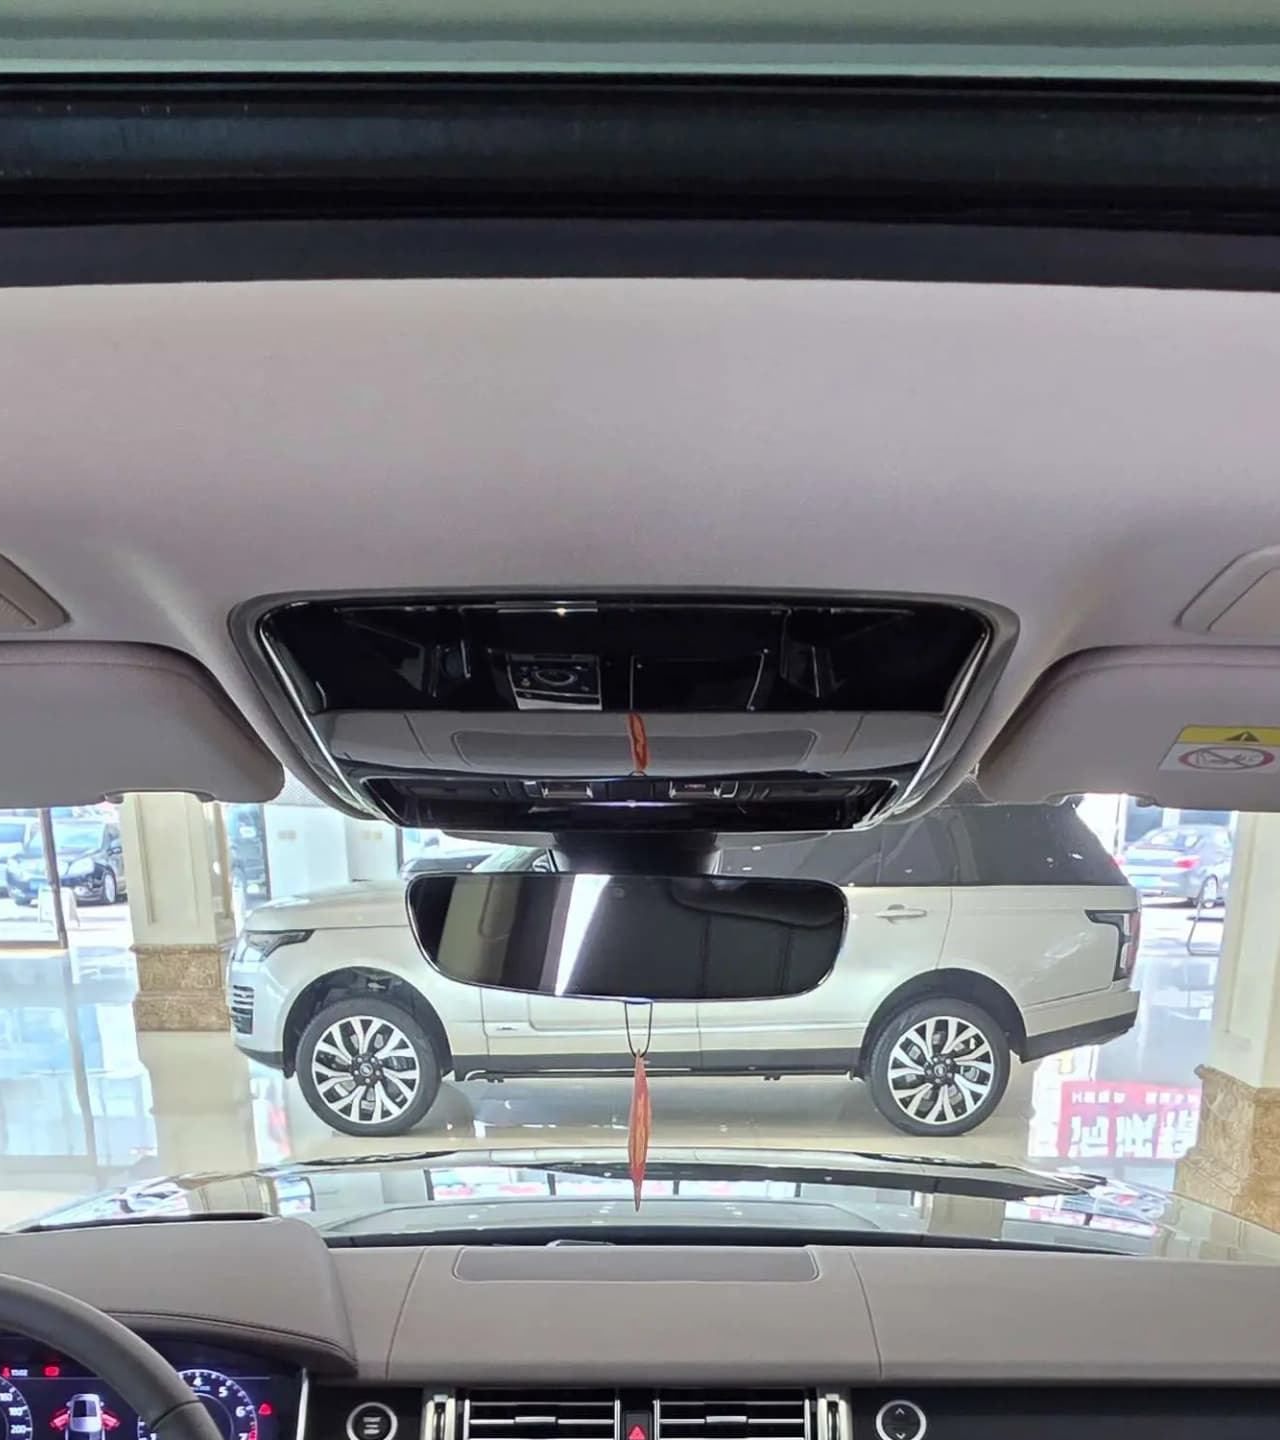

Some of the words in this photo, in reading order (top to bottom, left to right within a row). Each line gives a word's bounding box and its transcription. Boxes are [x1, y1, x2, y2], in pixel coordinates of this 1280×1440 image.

[193, 1377, 203, 1387] 4
[218, 1386, 228, 1398] 5
[235, 1406, 246, 1418] 6
